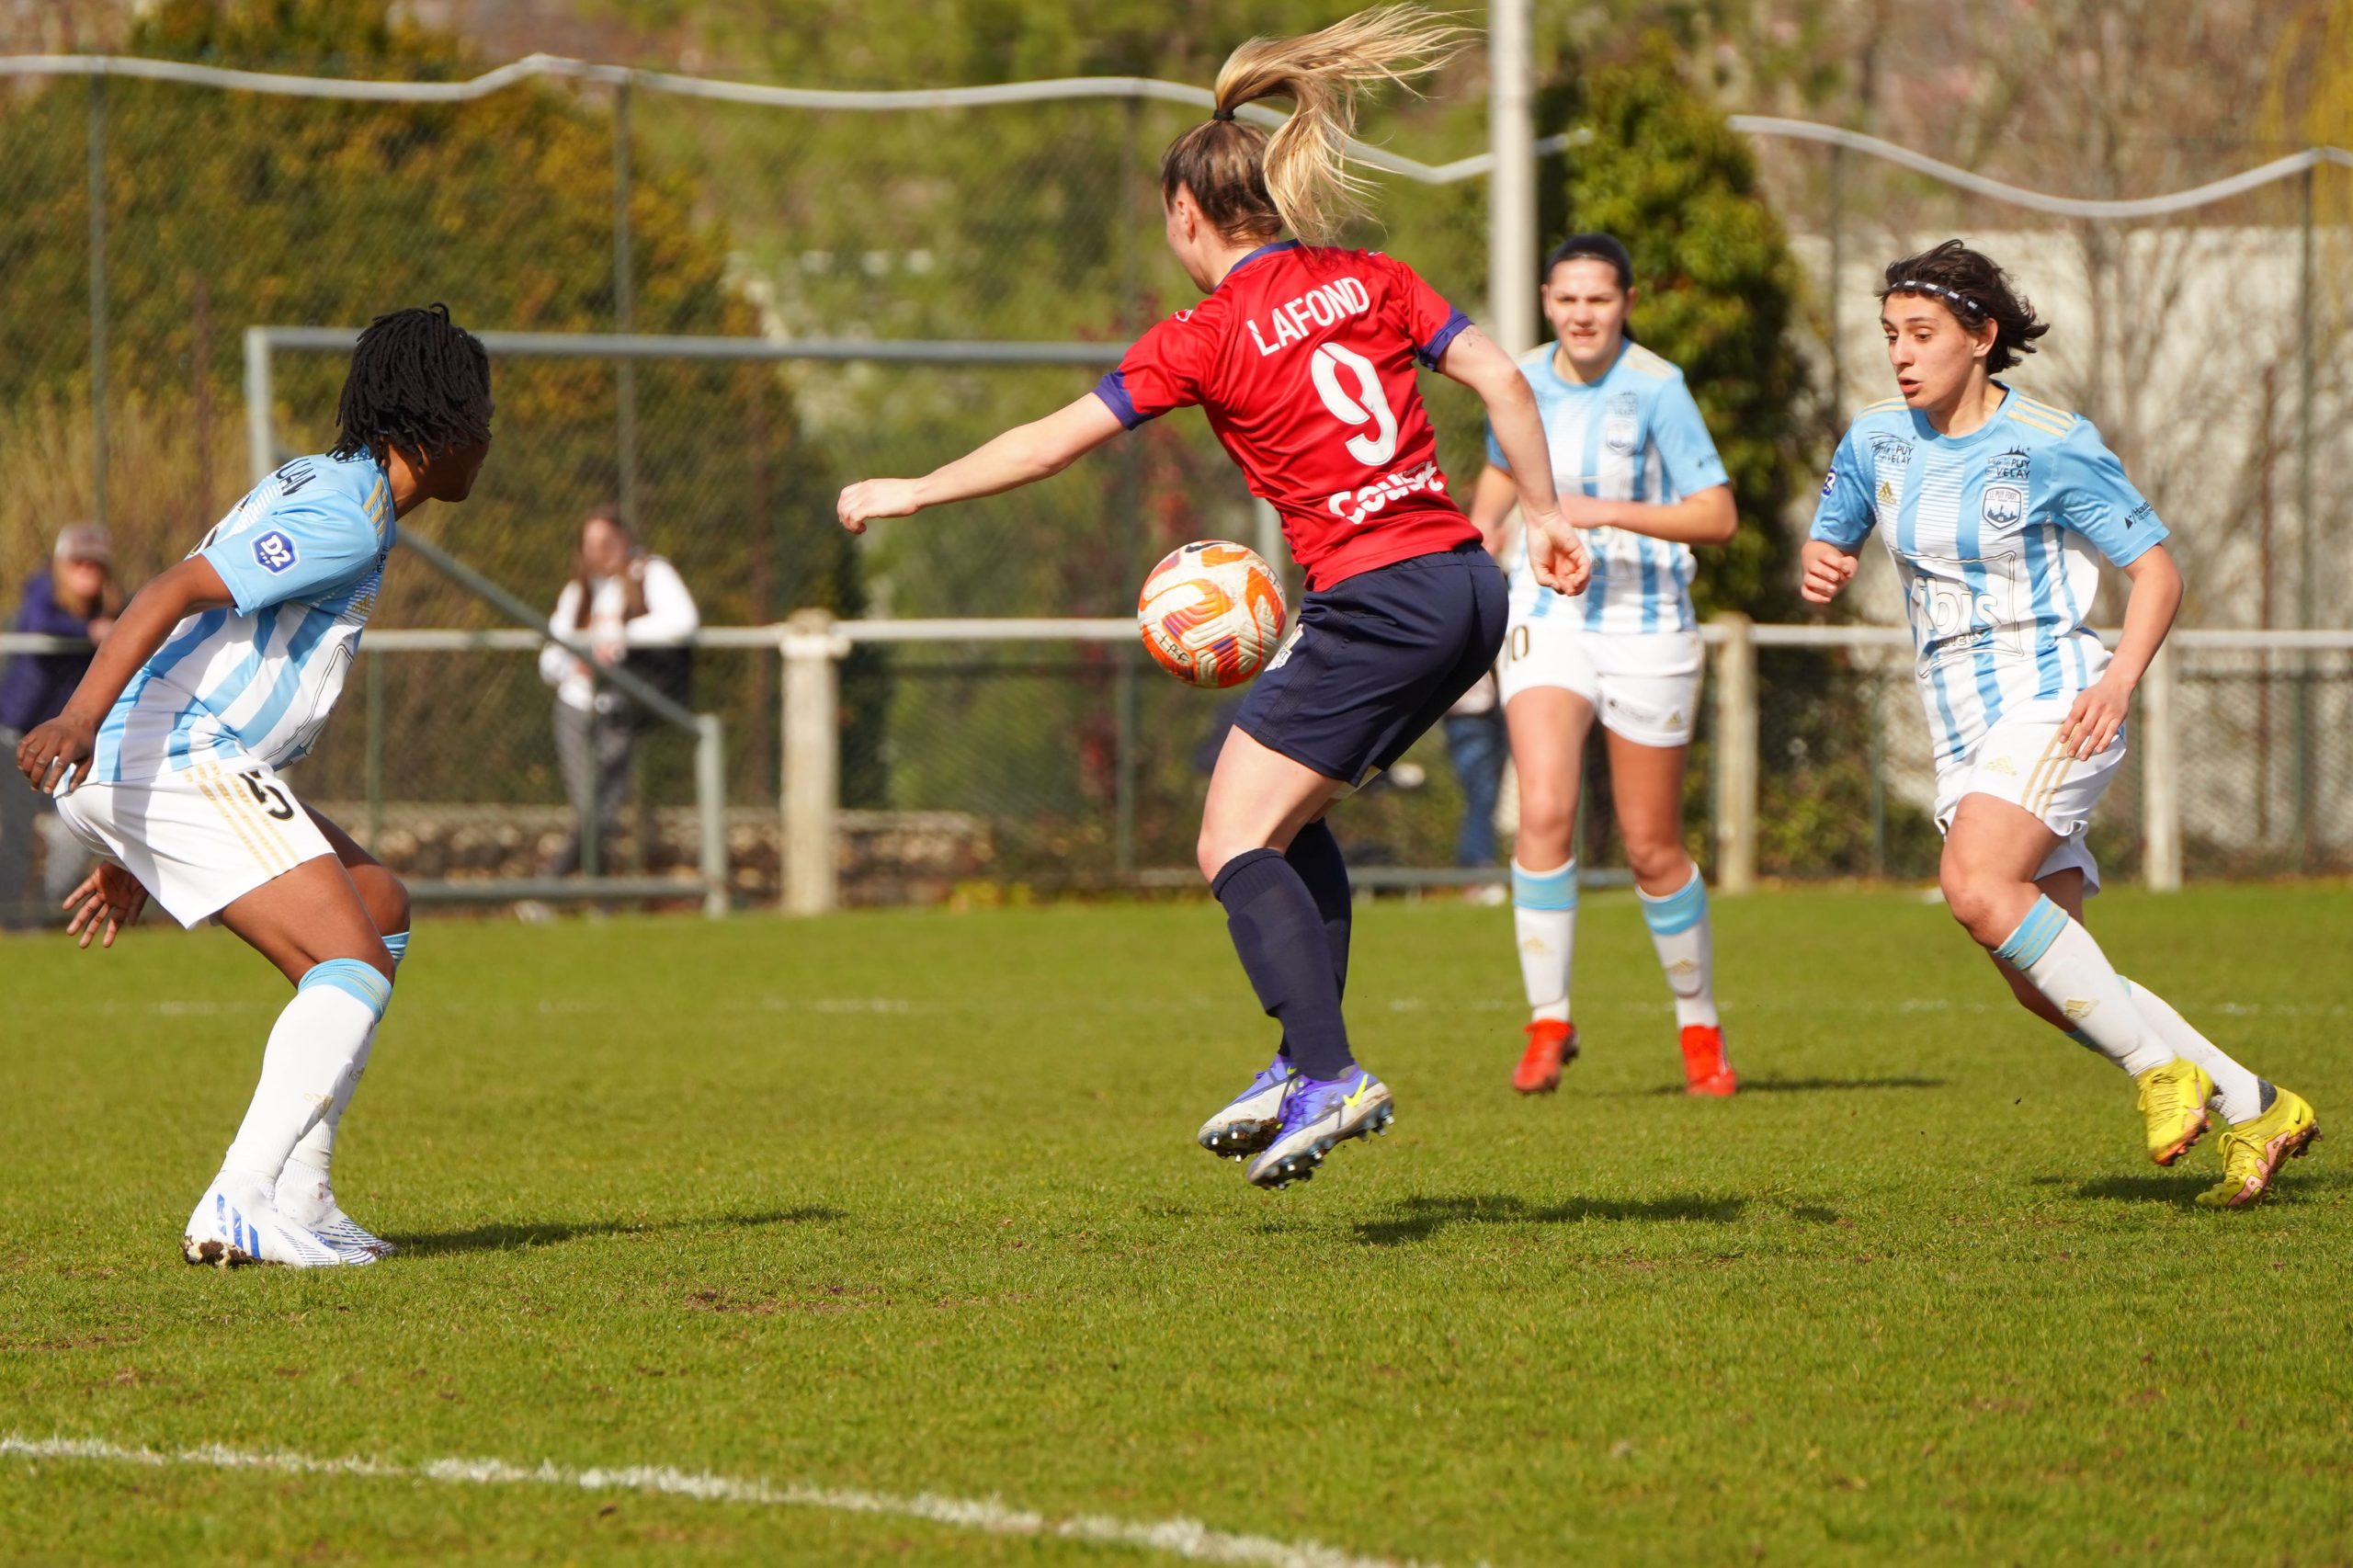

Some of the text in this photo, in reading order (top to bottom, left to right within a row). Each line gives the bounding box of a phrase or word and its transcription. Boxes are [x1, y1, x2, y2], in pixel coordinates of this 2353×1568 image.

[1246, 277, 1370, 357] LAFOND
[1311, 342, 1397, 466] 9
[1996, 467, 2031, 479] VELAY
[2011, 459, 2030, 469] PUY
[260, 534, 291, 568] D2
[1911, 575, 2001, 636] ibis
[237, 768, 294, 821] 5
